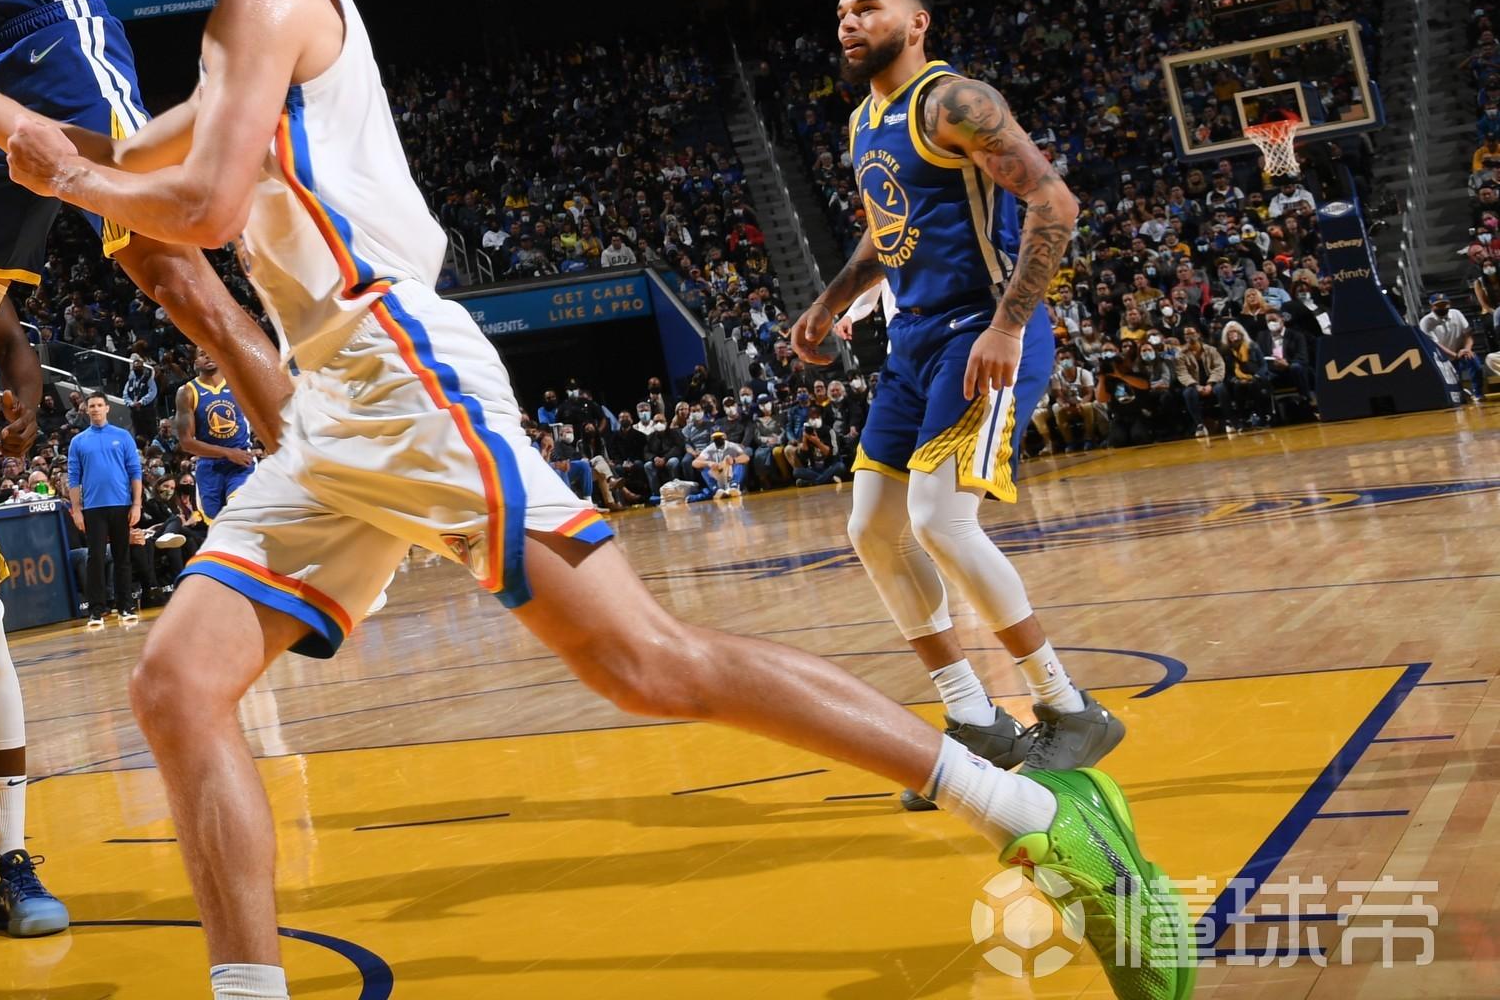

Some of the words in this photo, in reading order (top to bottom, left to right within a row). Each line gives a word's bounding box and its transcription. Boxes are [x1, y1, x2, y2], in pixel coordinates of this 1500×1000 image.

[133, 1, 162, 16] KAISER
[877, 150, 900, 173] STATE
[883, 181, 898, 207] 2
[1325, 238, 1363, 250] betway
[1333, 267, 1371, 283] xfinity
[552, 291, 583, 306] GET
[591, 284, 636, 300] CARE
[548, 307, 587, 322] LIKE
[593, 302, 605, 316] A
[611, 298, 645, 313] PRO
[225, 410, 231, 418] 9
[29, 503, 50, 512] CHASE
[9, 554, 55, 588] PRO
